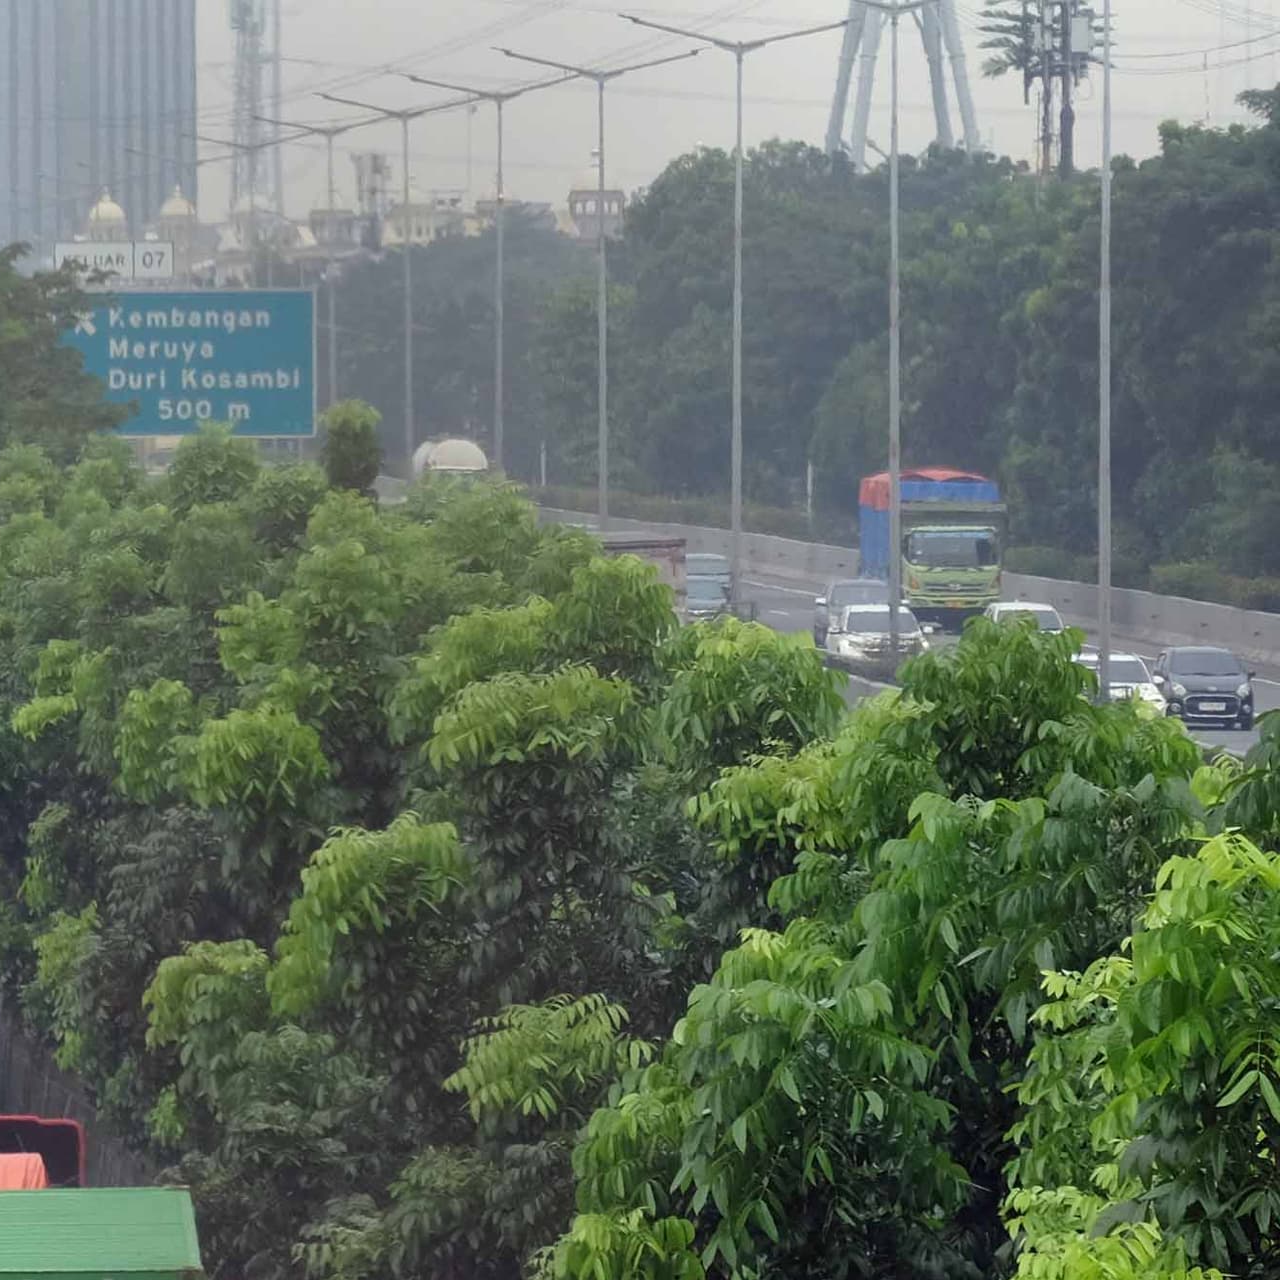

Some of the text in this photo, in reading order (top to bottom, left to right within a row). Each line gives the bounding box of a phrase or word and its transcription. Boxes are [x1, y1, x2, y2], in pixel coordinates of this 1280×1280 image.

[142, 252, 165, 269] 07
[109, 307, 271, 333] Kembangan
[109, 338, 215, 362] Meruya
[108, 368, 300, 390] Duri Kosambi
[158, 400, 251, 421] 500 m
